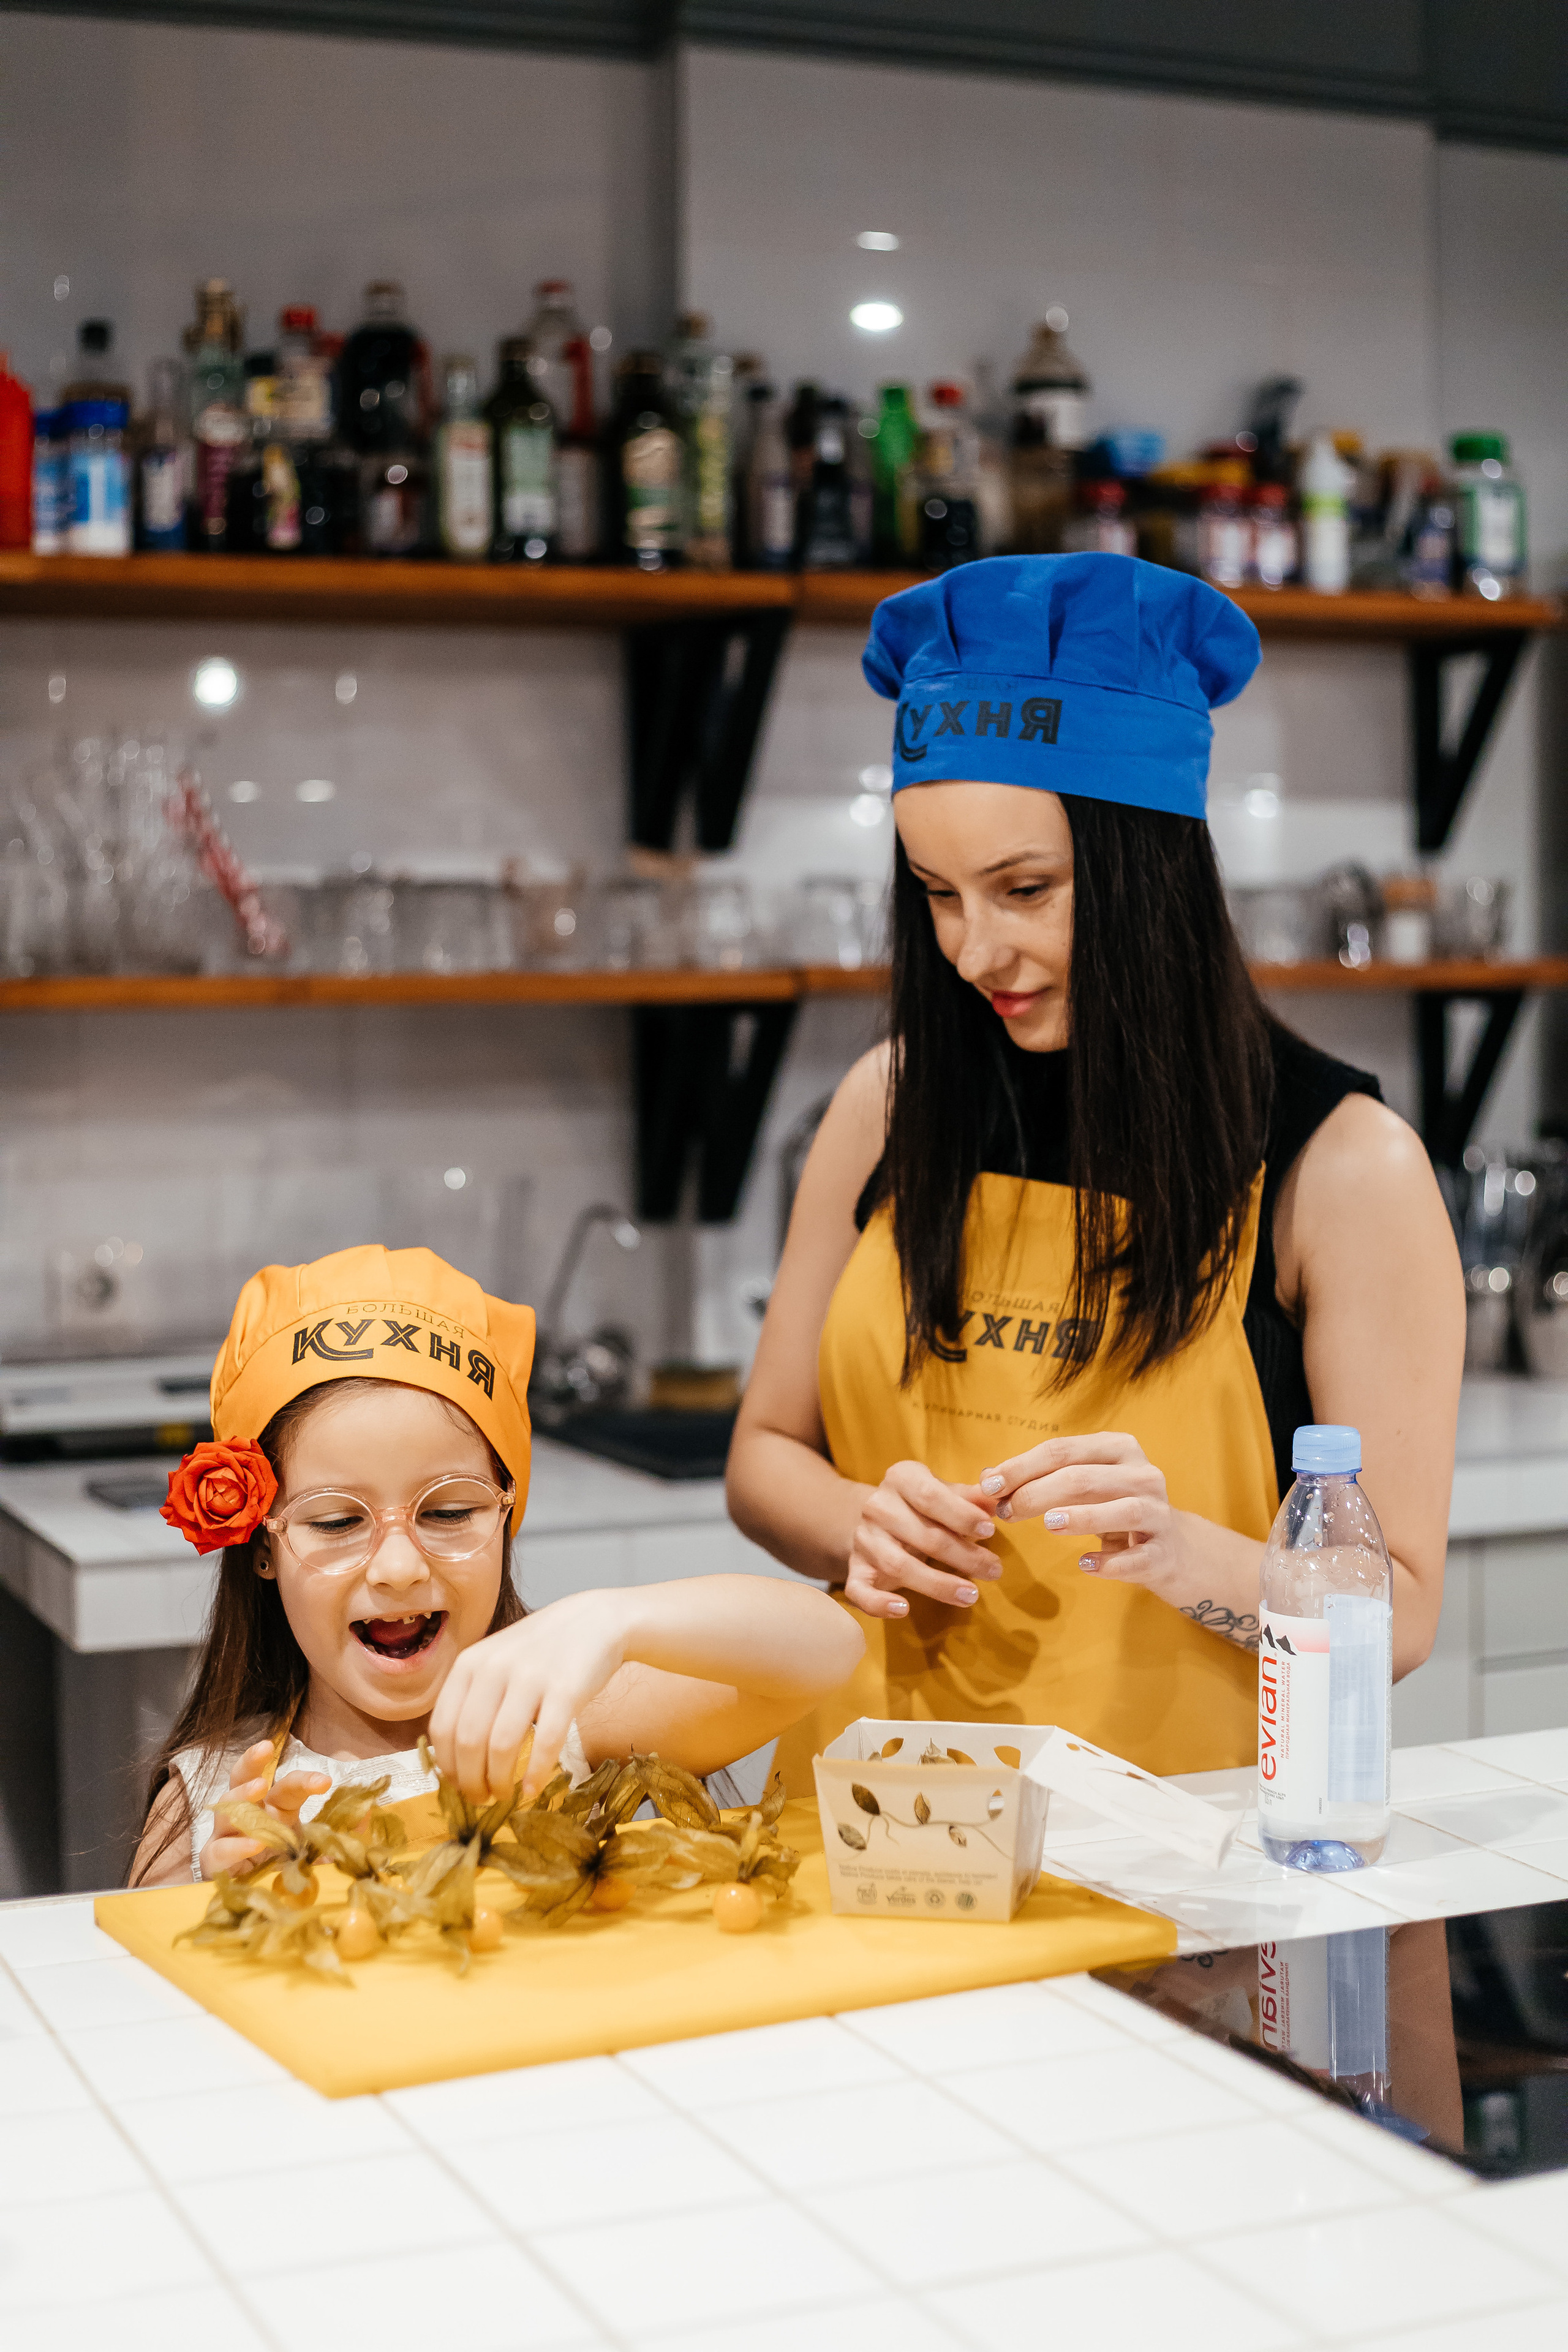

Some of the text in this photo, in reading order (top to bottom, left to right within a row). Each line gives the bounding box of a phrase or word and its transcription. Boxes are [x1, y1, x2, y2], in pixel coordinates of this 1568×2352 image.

[292, 1317, 496, 1401] КУХНЯ
[346, 1303, 465, 1338] БОЛЬШАЯ
[1260, 1656, 1277, 1781] evian
